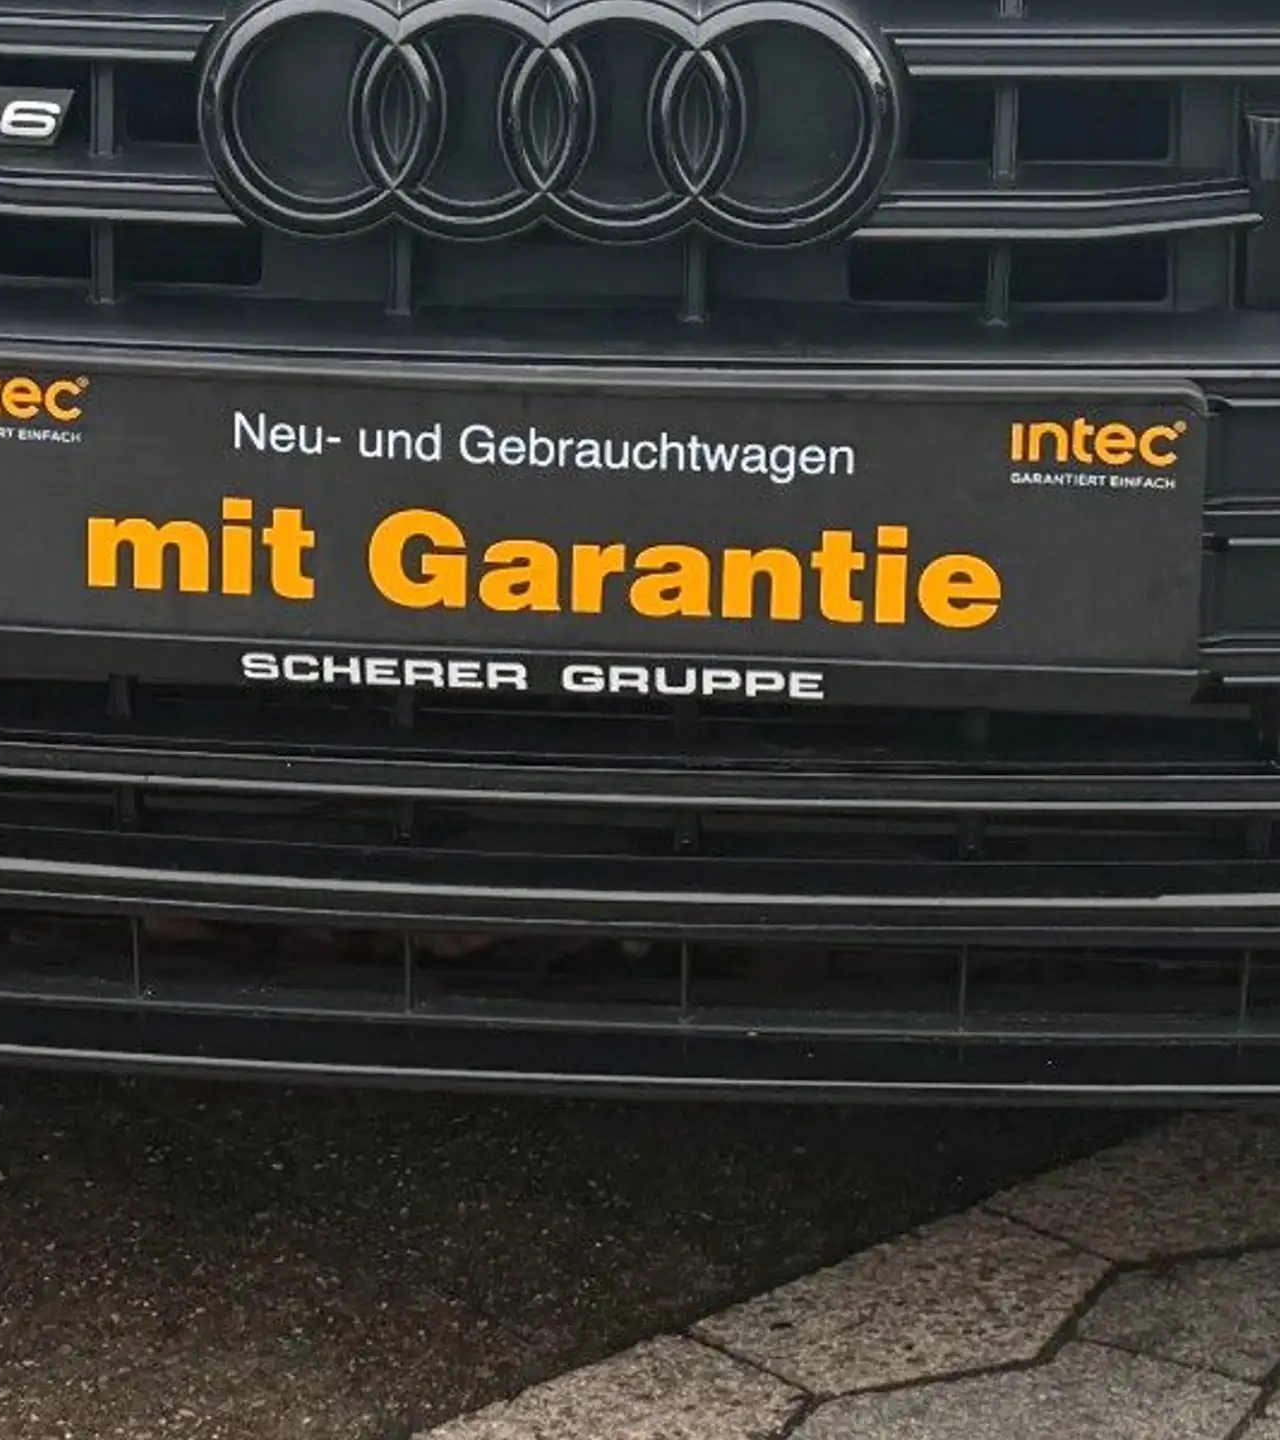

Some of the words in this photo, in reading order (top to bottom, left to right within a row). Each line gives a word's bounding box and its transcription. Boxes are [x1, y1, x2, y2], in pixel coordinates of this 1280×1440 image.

[18, 427, 83, 444] EINFACH
[232, 410, 342, 455] Neu-
[358, 422, 442, 462] und
[459, 424, 856, 485] Gebrauchtwagen
[1010, 471, 1107, 488] GARANTIERT
[1110, 475, 1178, 490] EINFACH
[87, 496, 316, 601] mit
[368, 507, 1002, 629] Garantie
[241, 651, 529, 692] SCHERER
[560, 662, 825, 701] GRUPPE
